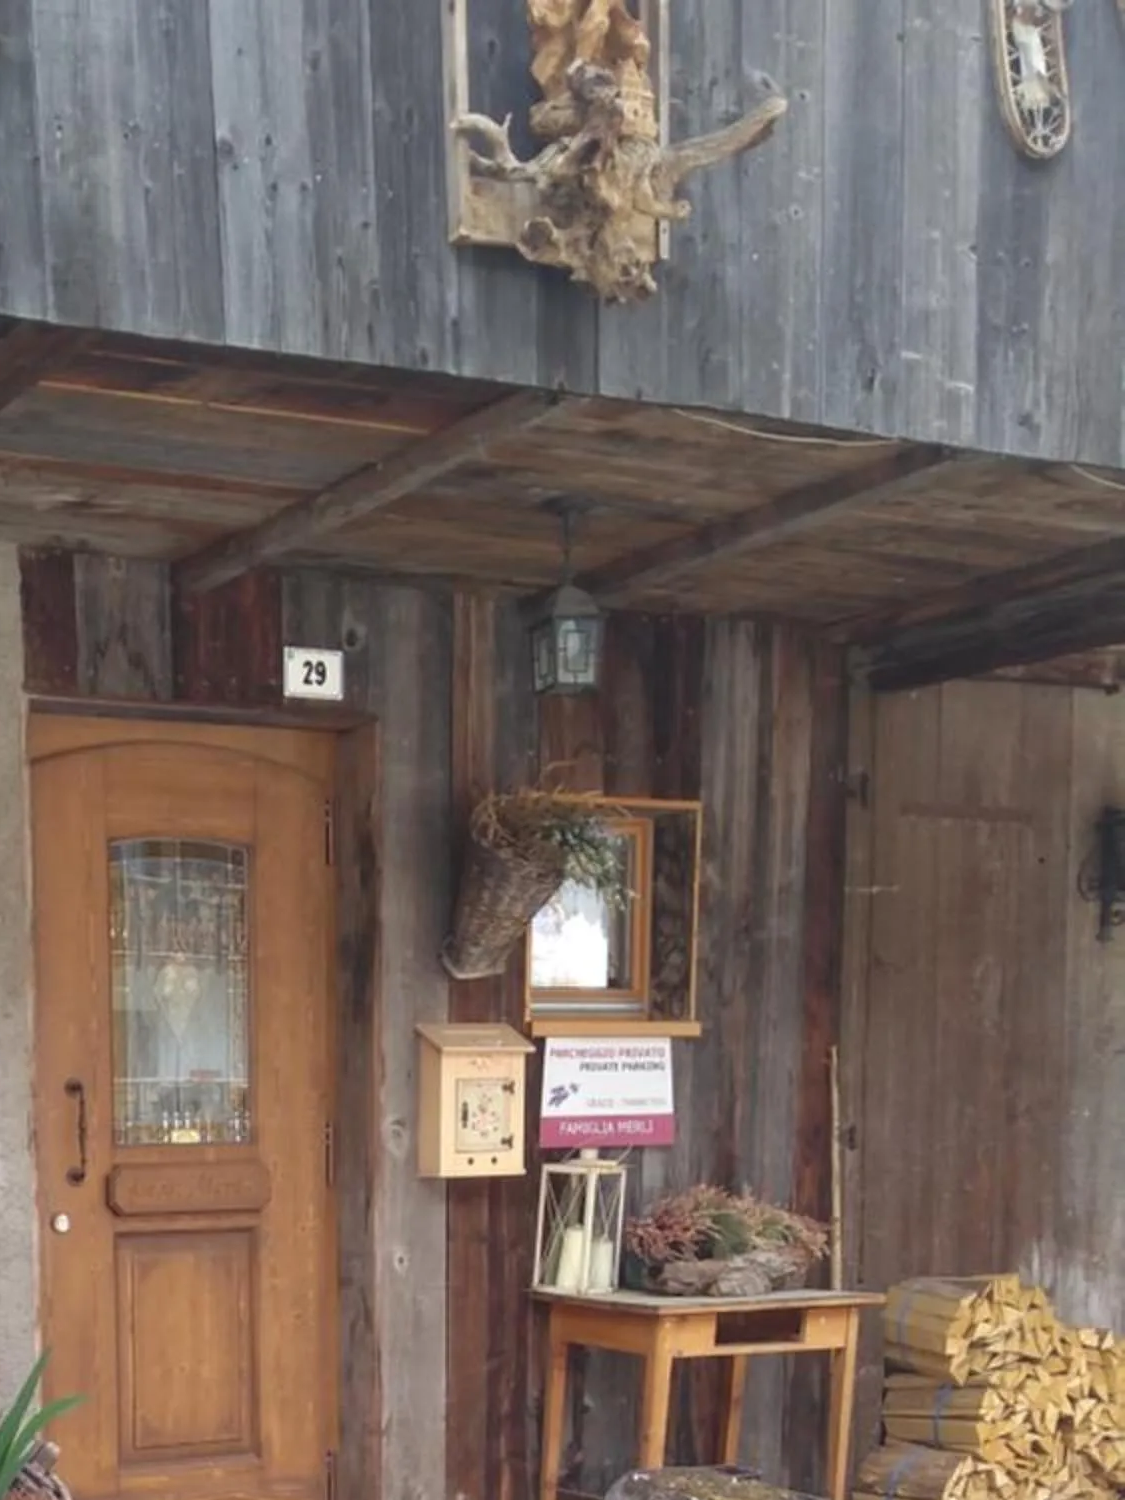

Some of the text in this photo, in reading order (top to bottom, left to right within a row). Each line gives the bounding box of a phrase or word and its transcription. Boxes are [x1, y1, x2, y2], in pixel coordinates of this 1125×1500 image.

[302, 660, 327, 687] 29
[618, 1047, 666, 1058] PRIVATO
[578, 1062, 666, 1072] PRIVATE PARKING
